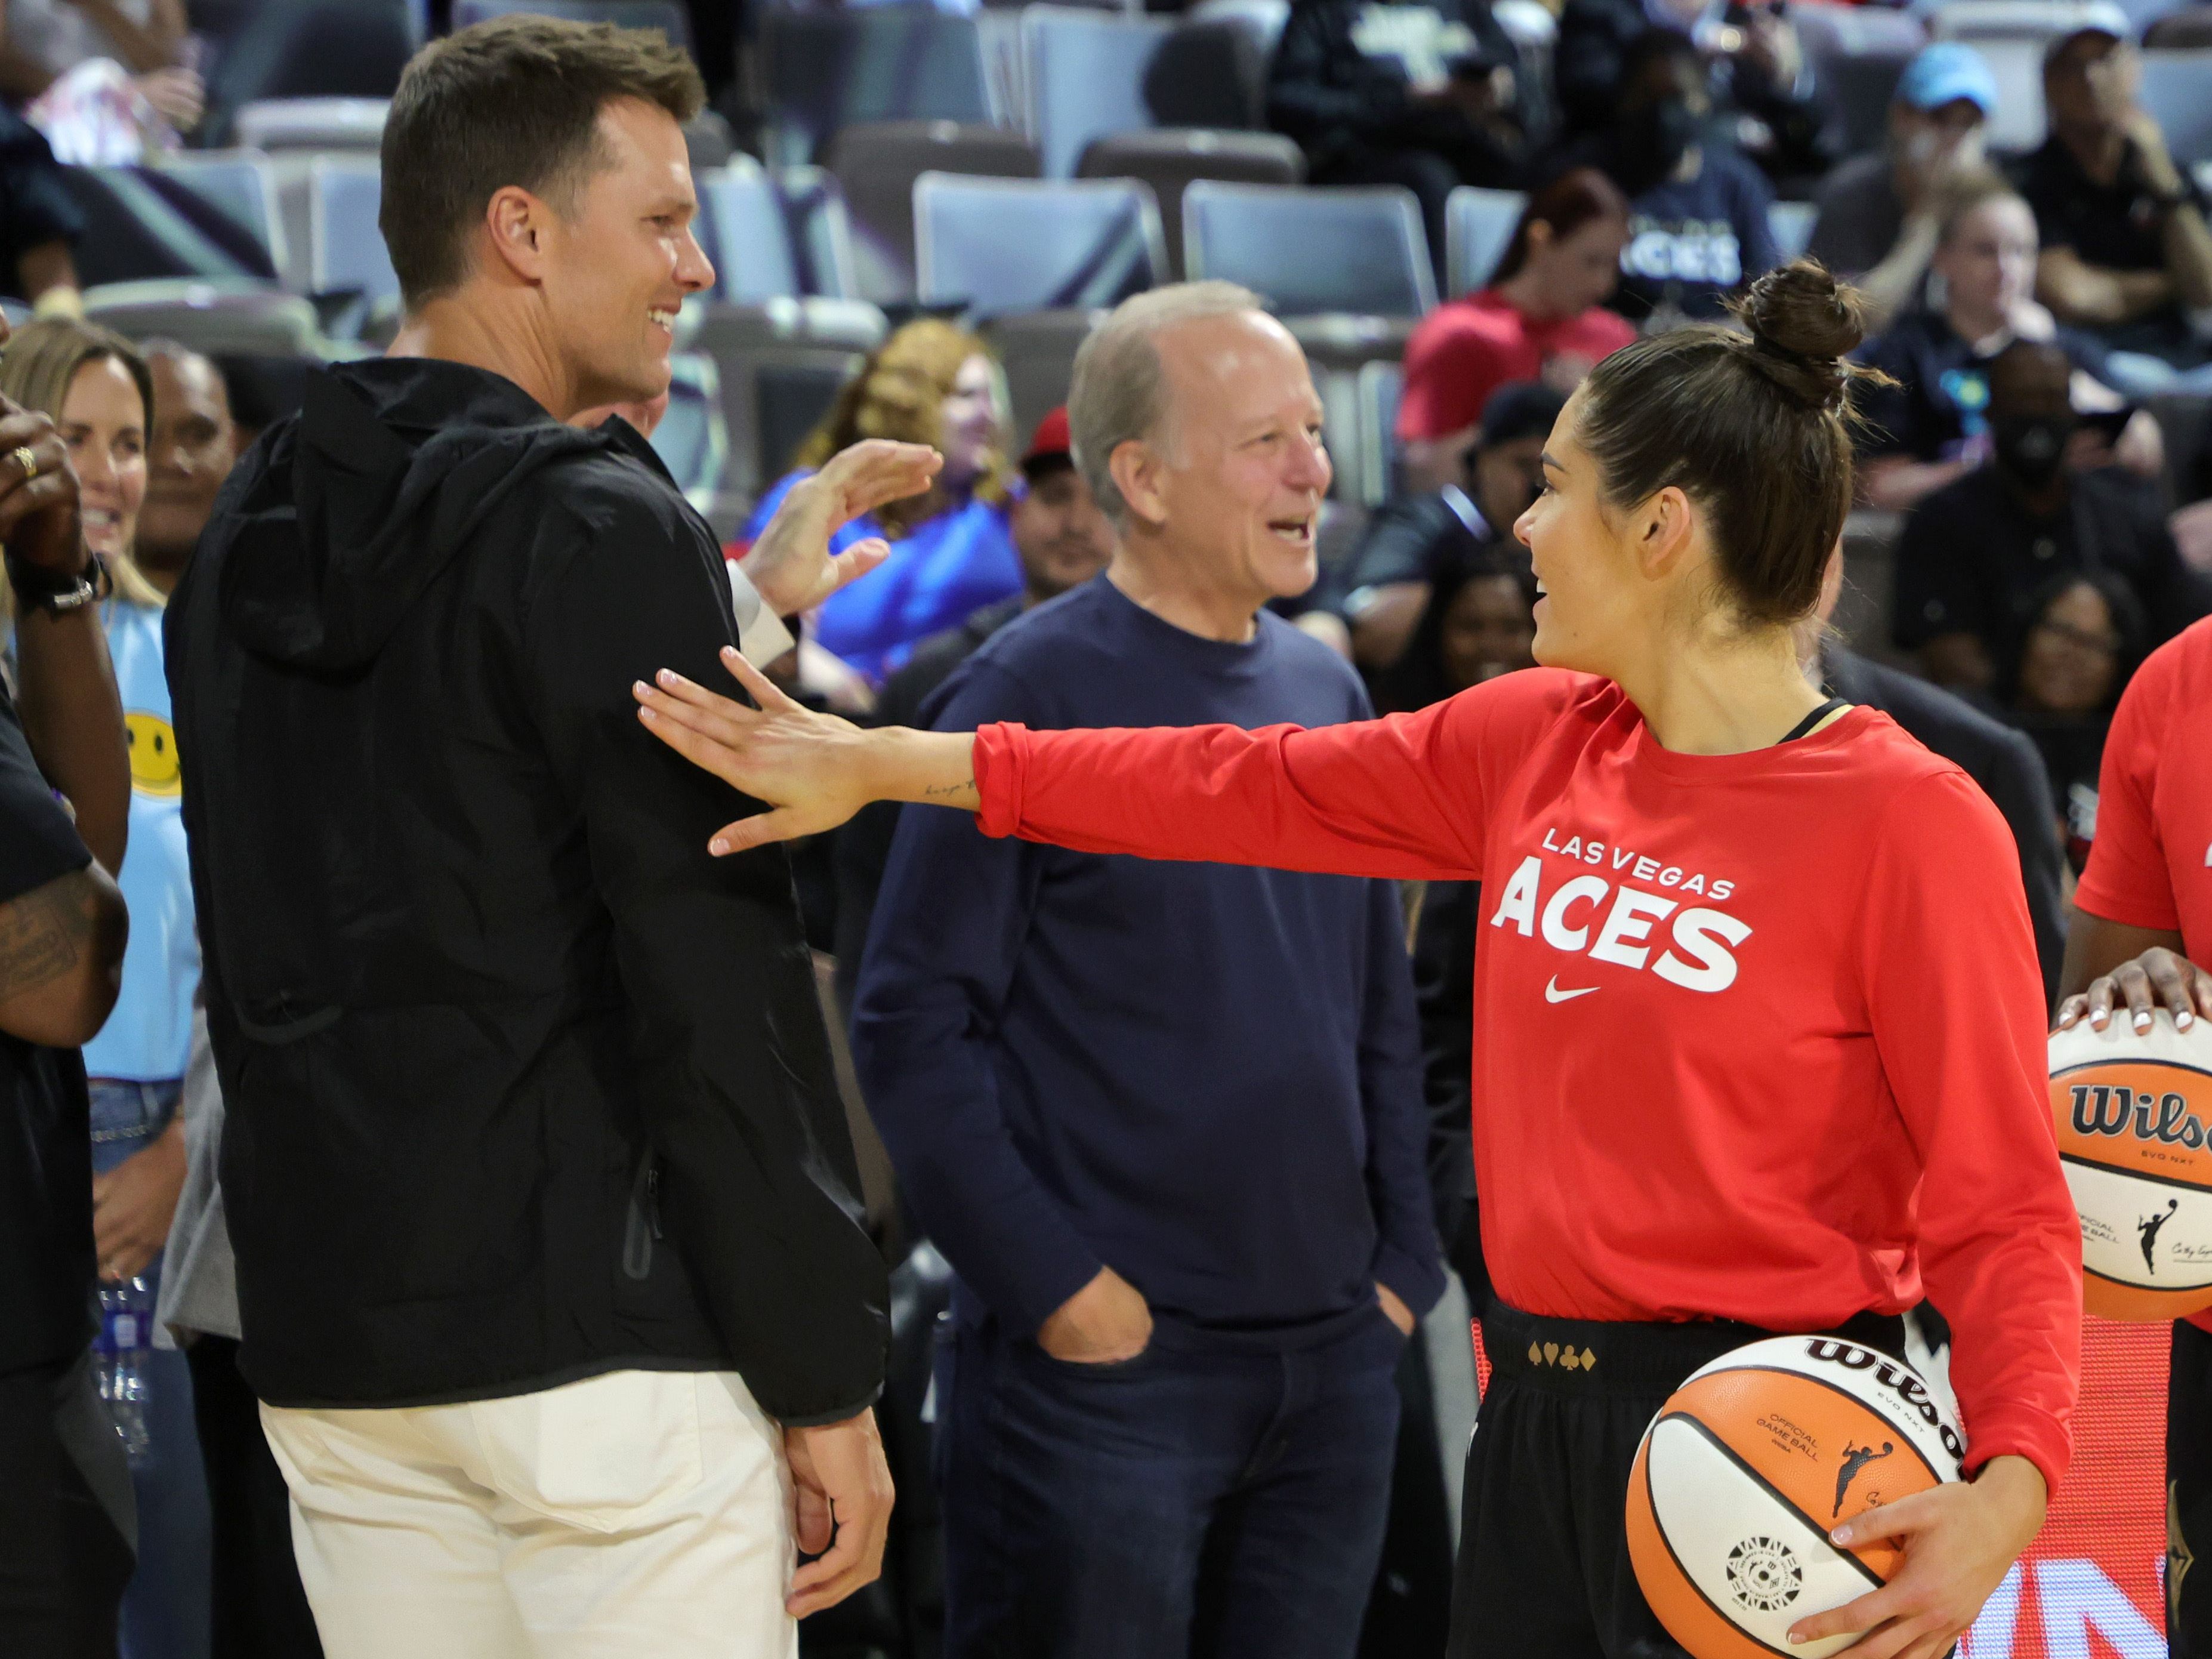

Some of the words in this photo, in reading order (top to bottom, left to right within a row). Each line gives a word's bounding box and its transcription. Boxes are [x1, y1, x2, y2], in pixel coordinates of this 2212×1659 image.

[1542, 827, 1605, 865] LAS
[1612, 847, 1735, 901] VEGAS
[1490, 855, 1754, 993] ACES
[2069, 1085, 2212, 1154] Wils
[1756, 1418, 1790, 1441] GAME
[1790, 1438, 1818, 1463] BALL
[1770, 1413, 1818, 1448] OFFICIAL
[1804, 1337, 1965, 1480] Wilso
[1877, 1392, 1901, 1410] EVO
[1904, 1413, 1925, 1433] NXT
